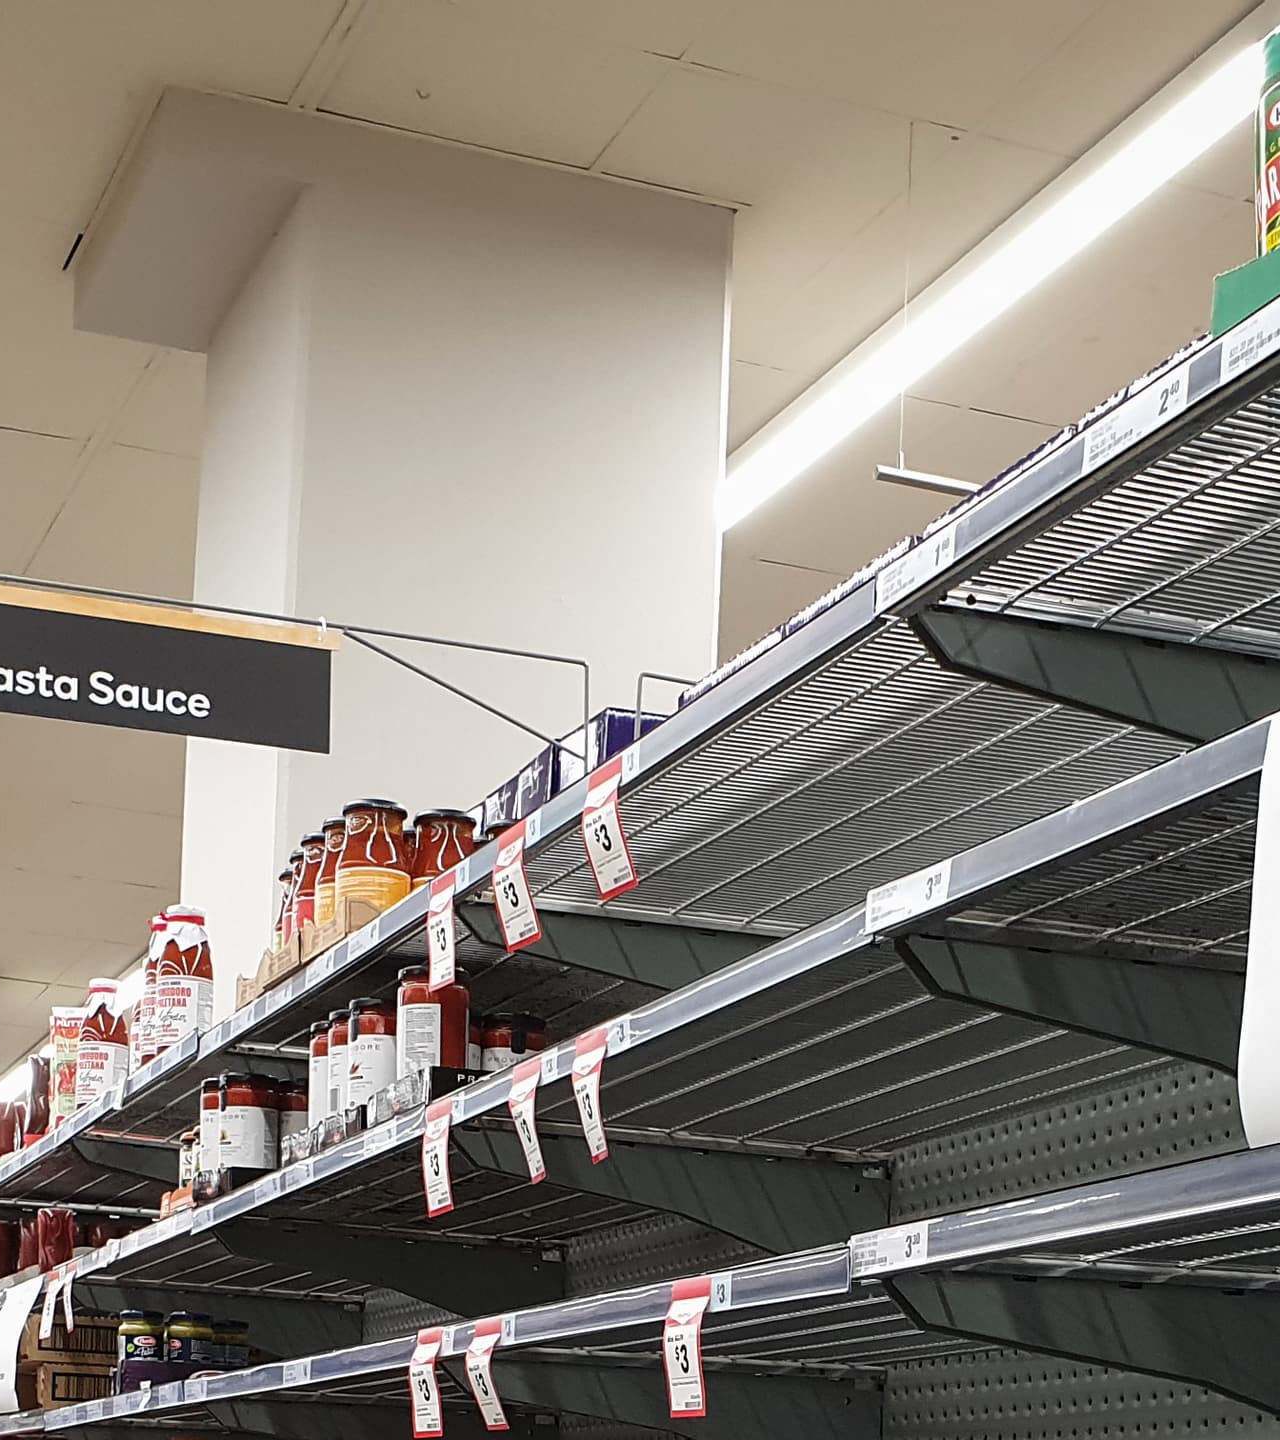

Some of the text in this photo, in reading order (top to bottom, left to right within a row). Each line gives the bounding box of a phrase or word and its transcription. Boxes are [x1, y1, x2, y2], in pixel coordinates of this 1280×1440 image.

[88, 671, 210, 718] Sauce
[594, 823, 612, 851] $3
[503, 882, 519, 908] $3
[436, 928, 447, 951] $3
[675, 1344, 690, 1374] $3
